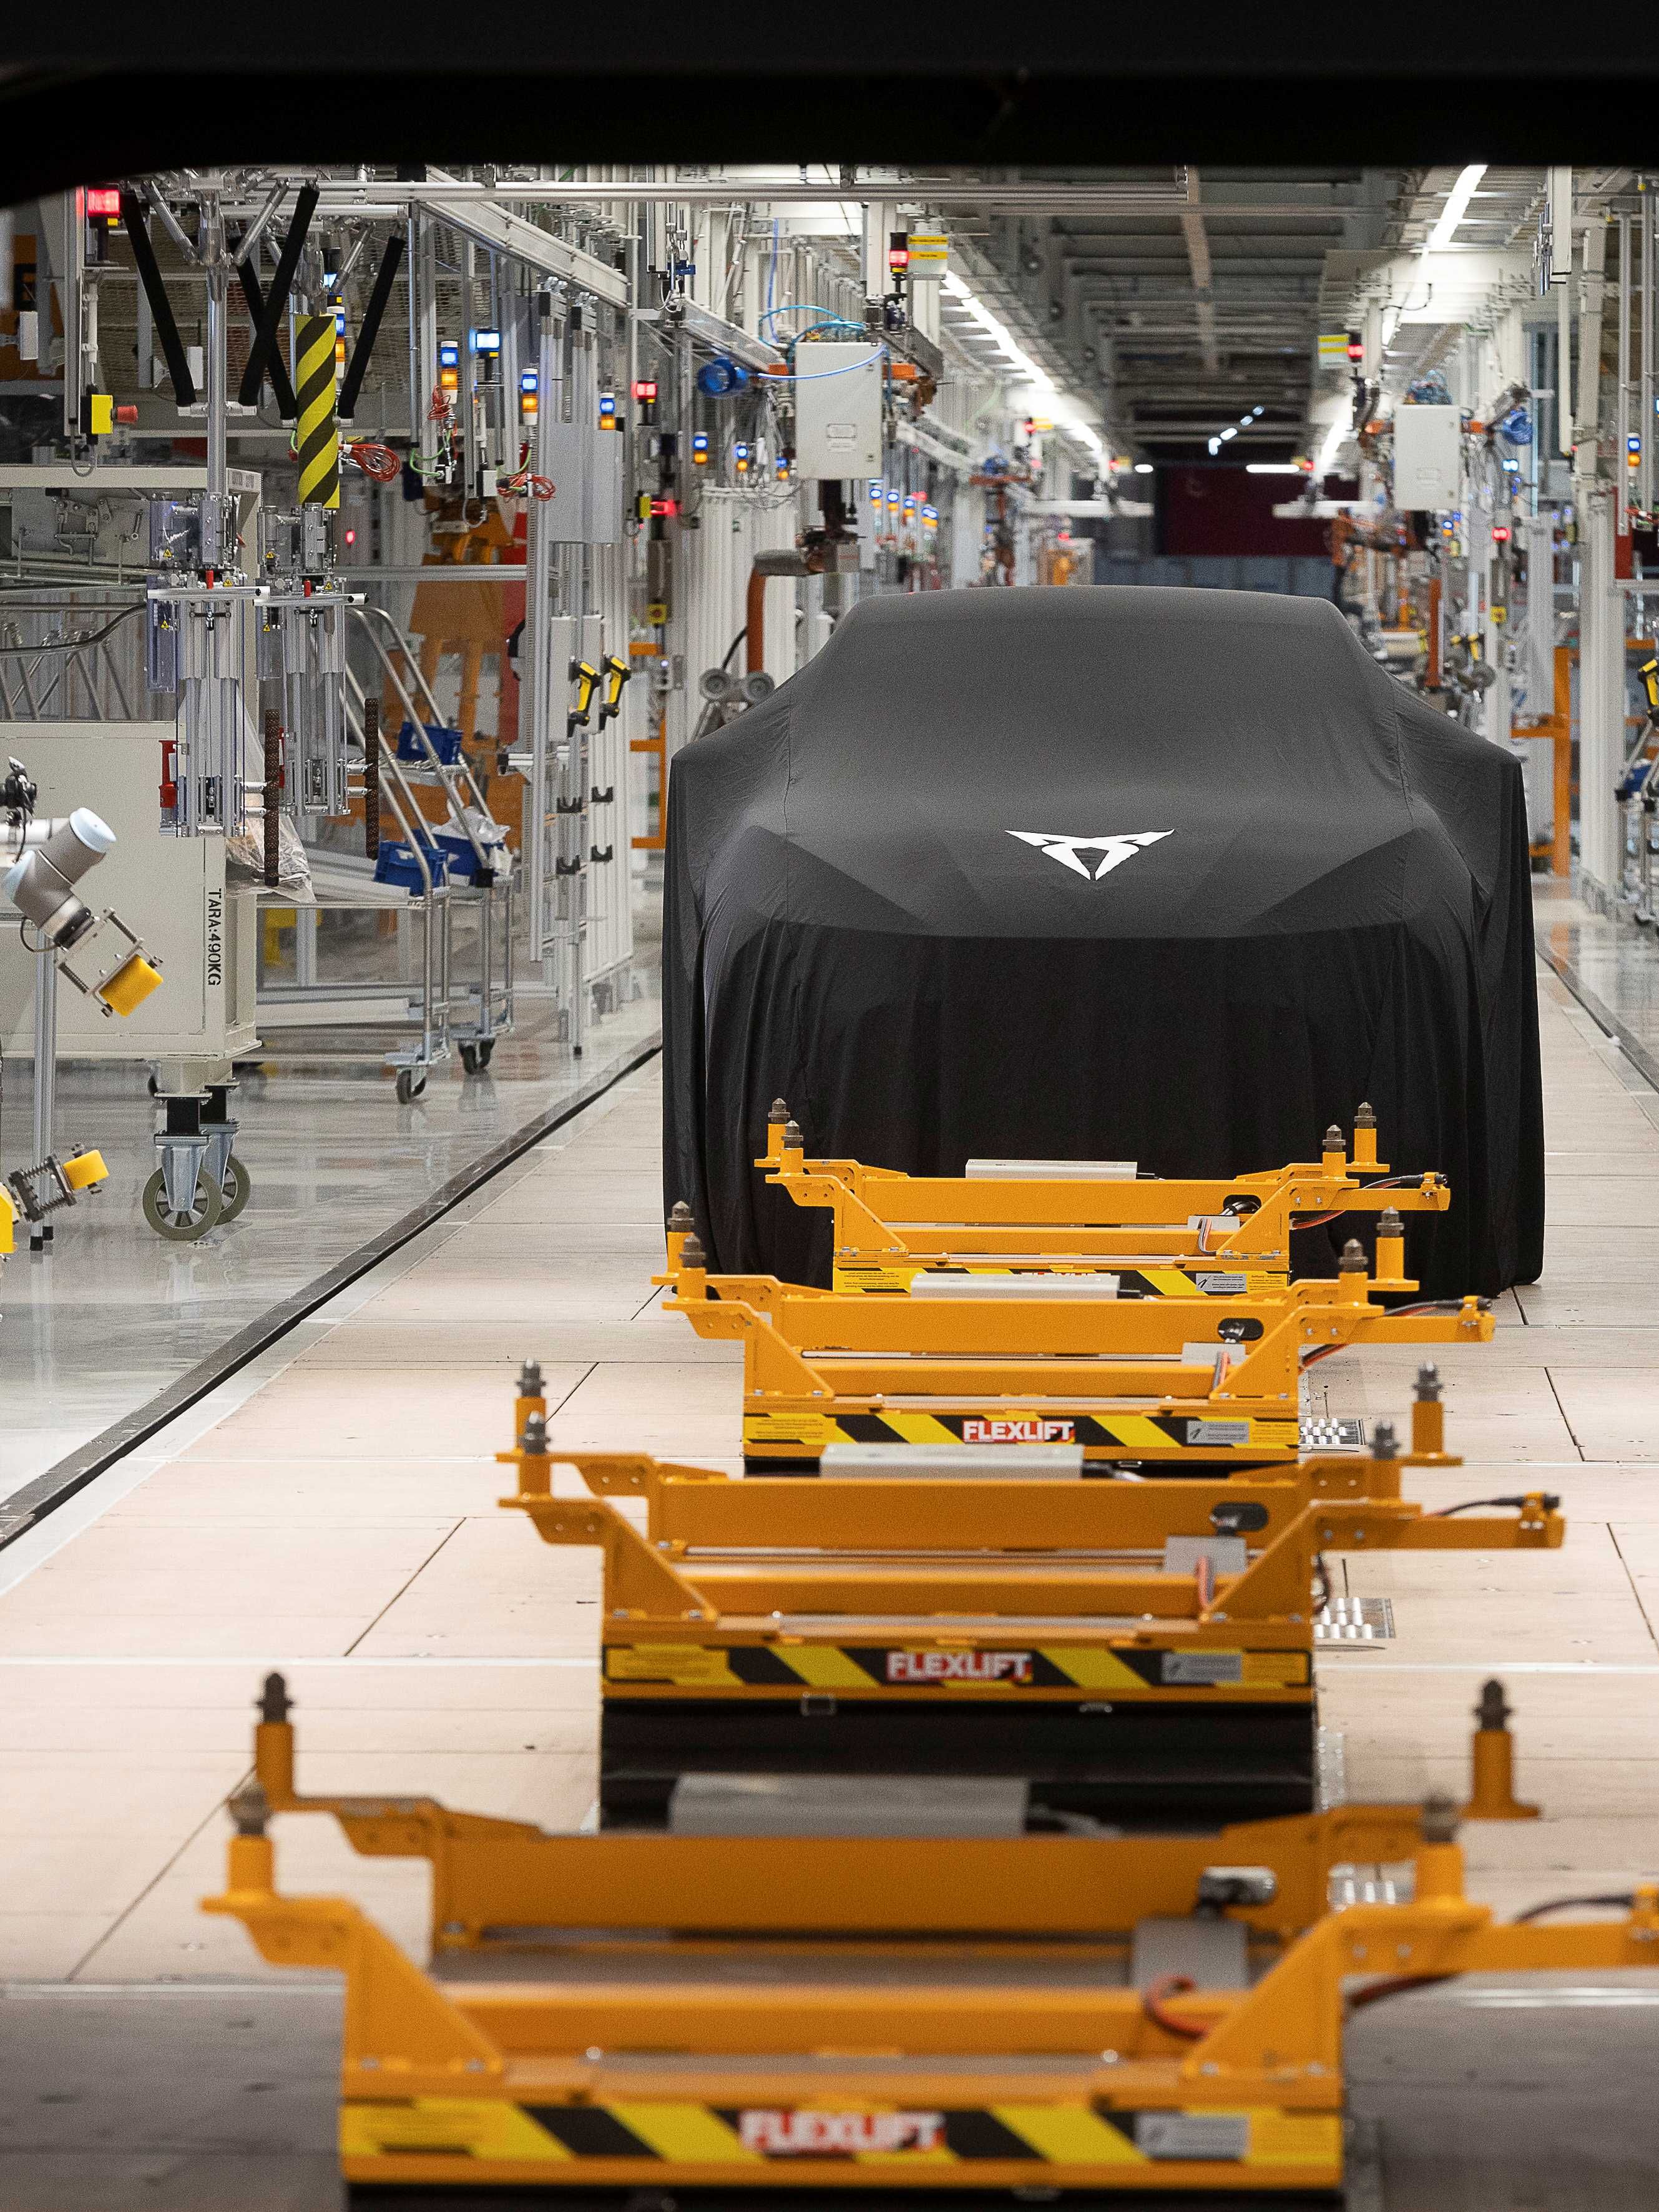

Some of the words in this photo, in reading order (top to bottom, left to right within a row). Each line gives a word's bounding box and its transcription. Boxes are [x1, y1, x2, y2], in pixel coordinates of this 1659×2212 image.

[963, 1421, 1074, 1440] FLEXLIFT
[887, 1651, 1032, 1679] FLEXLIFT
[740, 2111, 946, 2151] FLEXLIFT
